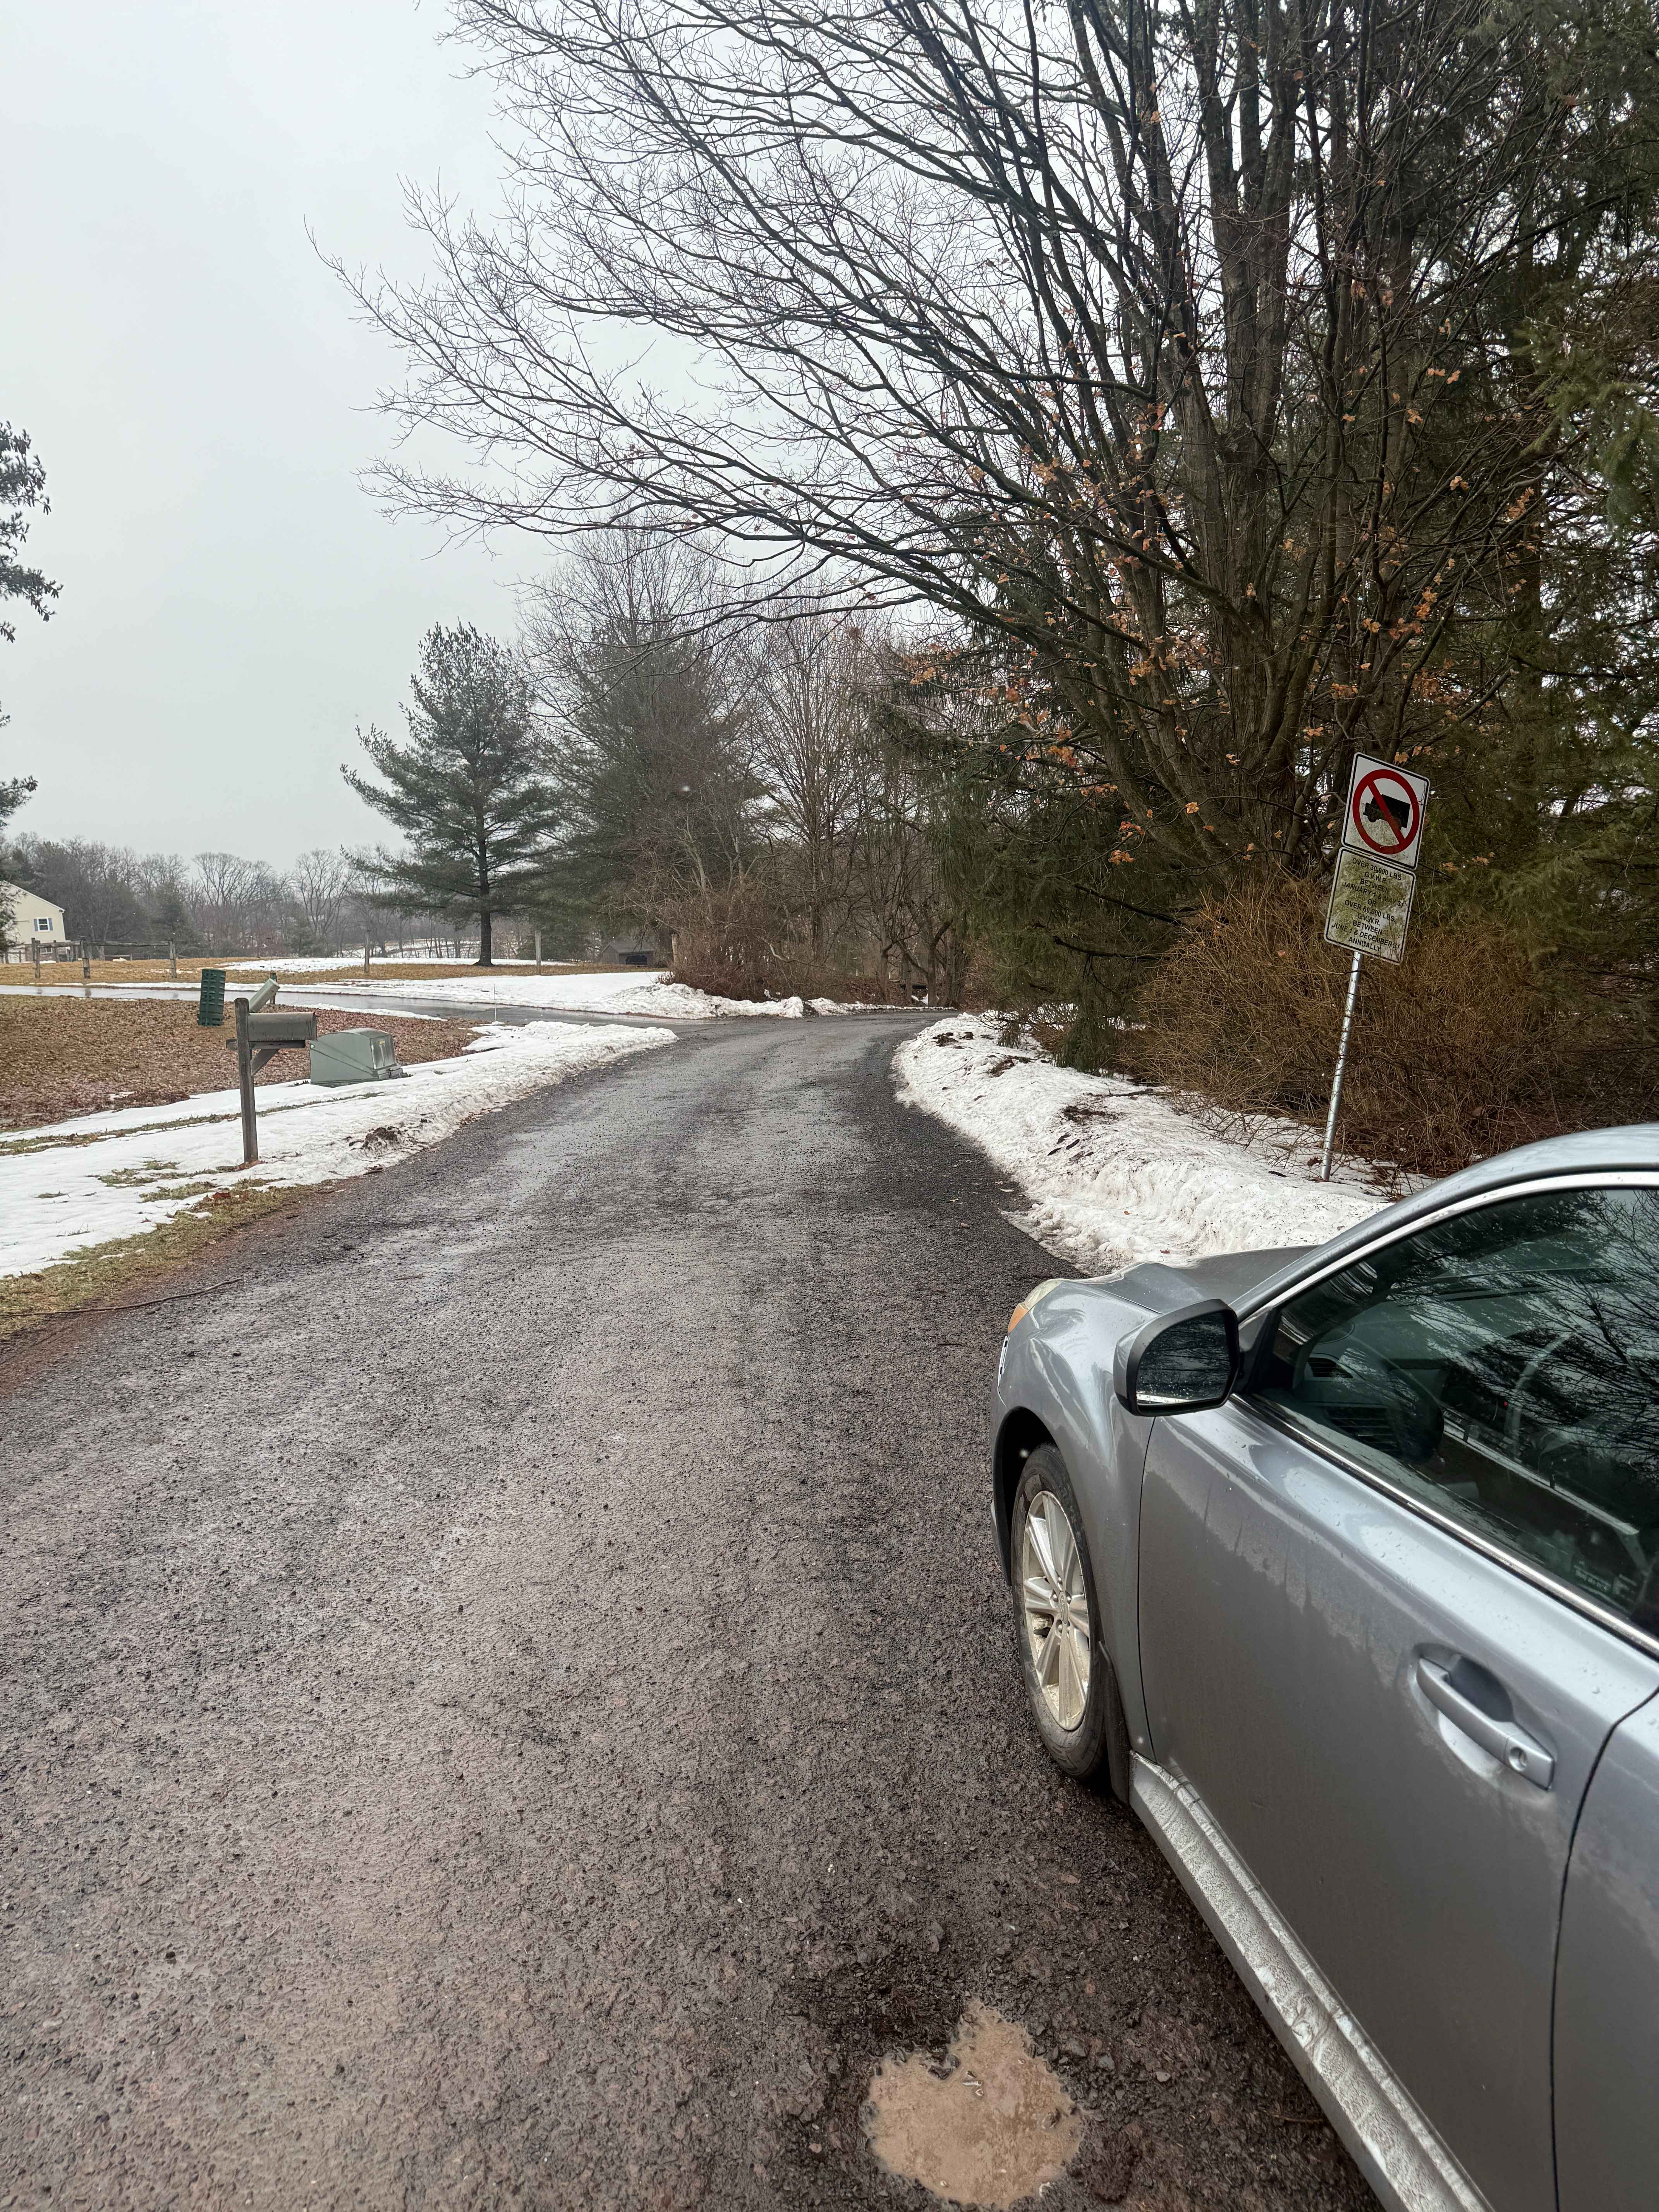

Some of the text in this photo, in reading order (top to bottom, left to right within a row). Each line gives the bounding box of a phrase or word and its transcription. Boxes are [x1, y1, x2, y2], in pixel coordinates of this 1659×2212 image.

[1352, 858, 1369, 869] OVER
[1342, 882, 1372, 896] JANUARY
[1383, 896, 1397, 904] MAY
[1360, 878, 1389, 893] BETWEEN
[1345, 900, 1362, 910] OVER
[1332, 922, 1348, 932] JUNE
[1359, 931, 1393, 947] DECEMBER
[1353, 920, 1382, 935] BETWEEN
[1348, 937, 1381, 951] ANNUALLY
